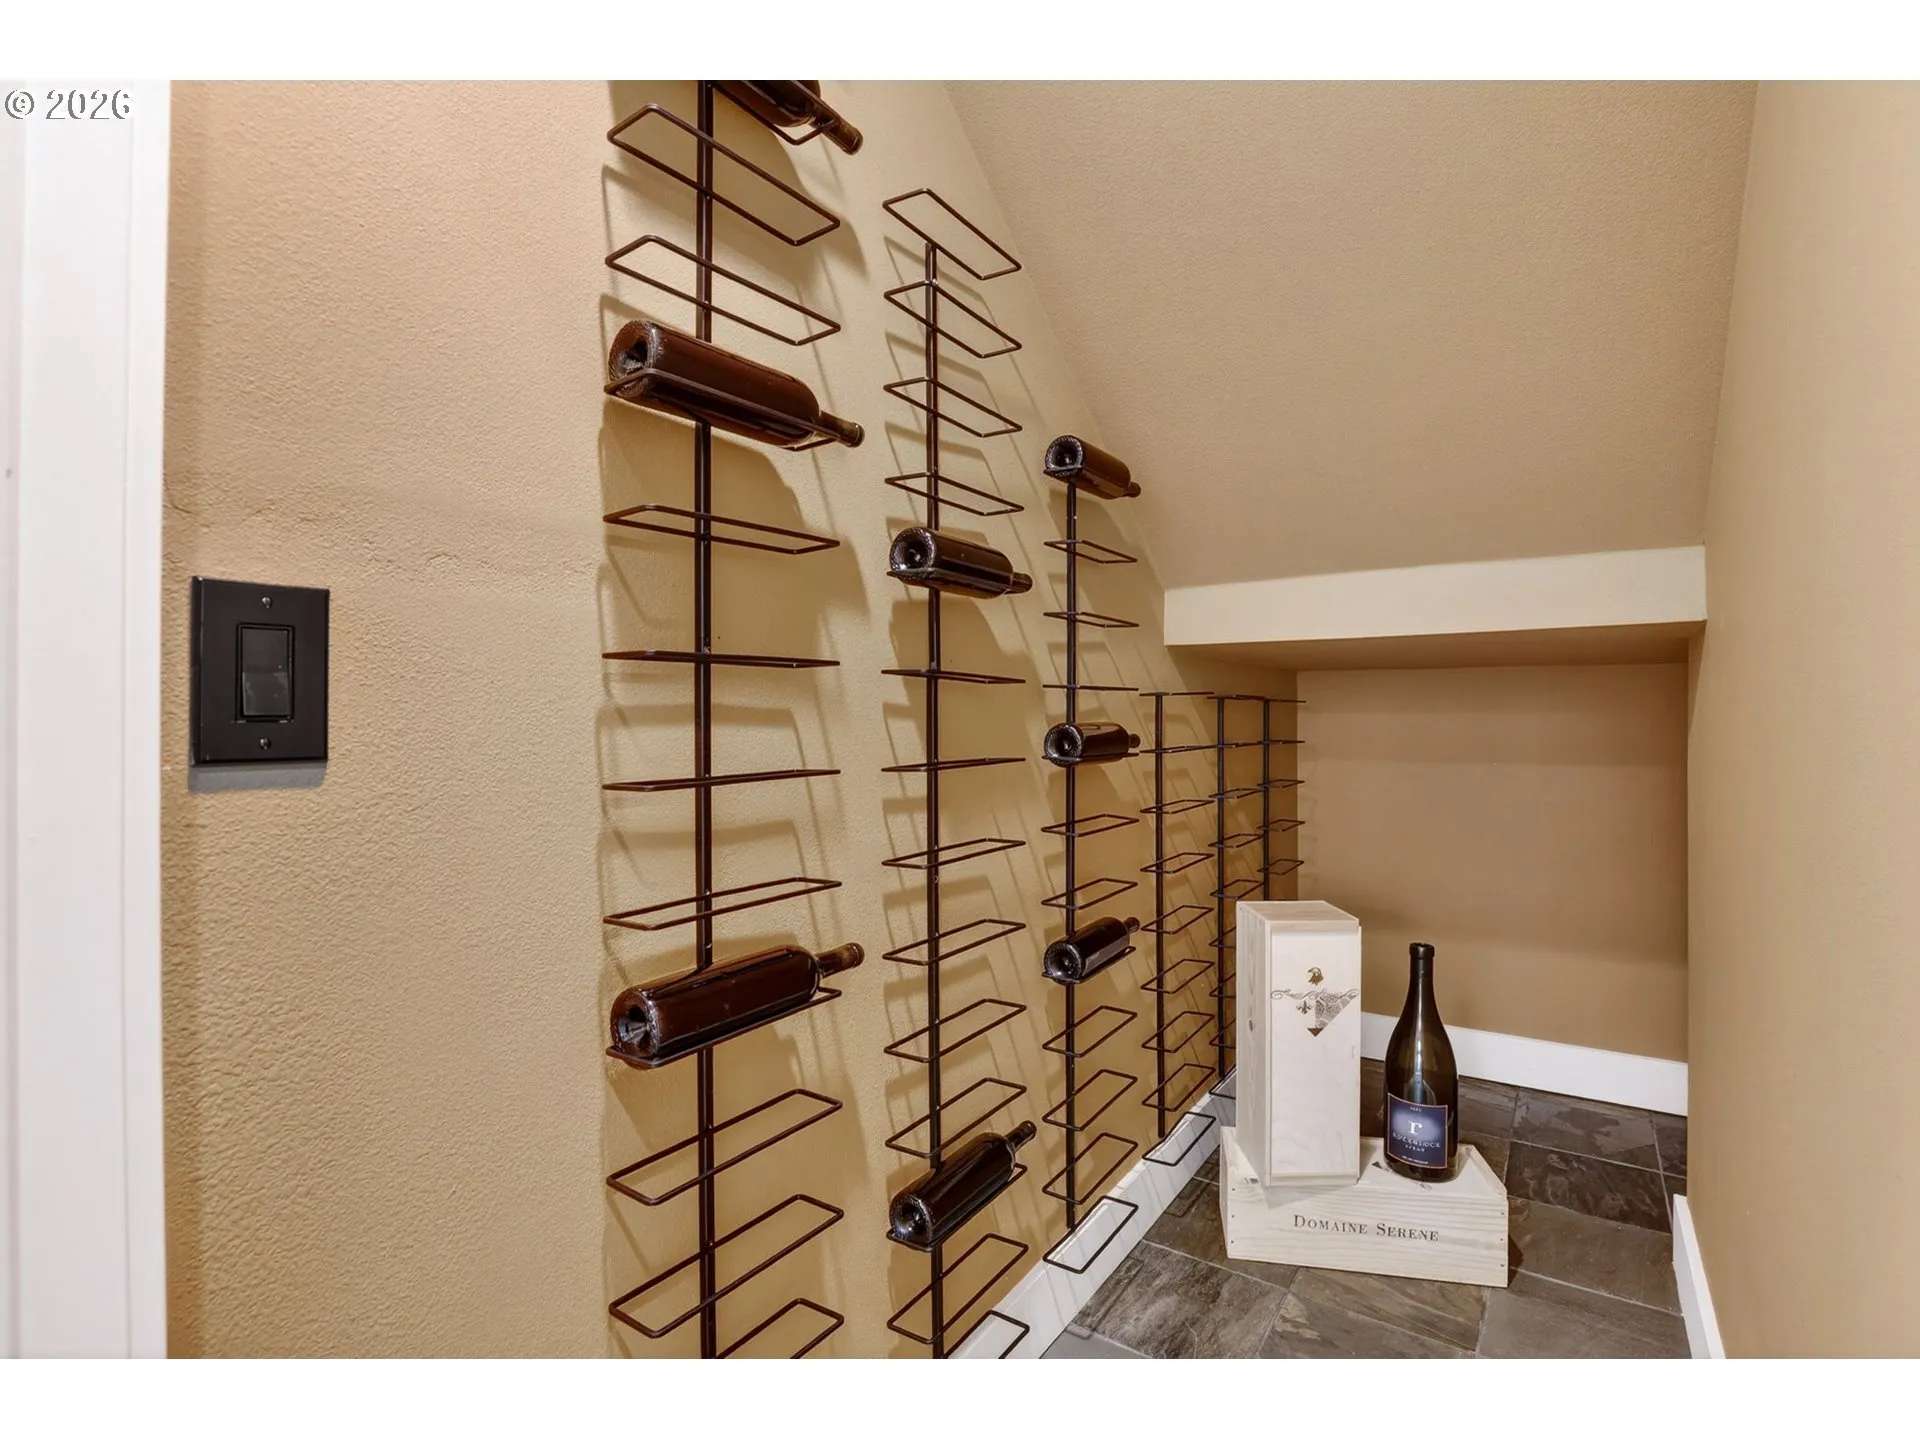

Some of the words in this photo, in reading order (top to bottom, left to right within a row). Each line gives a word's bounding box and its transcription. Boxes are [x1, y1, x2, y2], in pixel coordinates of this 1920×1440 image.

[1408, 1120, 1423, 1135] r
[1293, 1214, 1368, 1235] DOMAINE
[1376, 1222, 1439, 1242] SERENE
